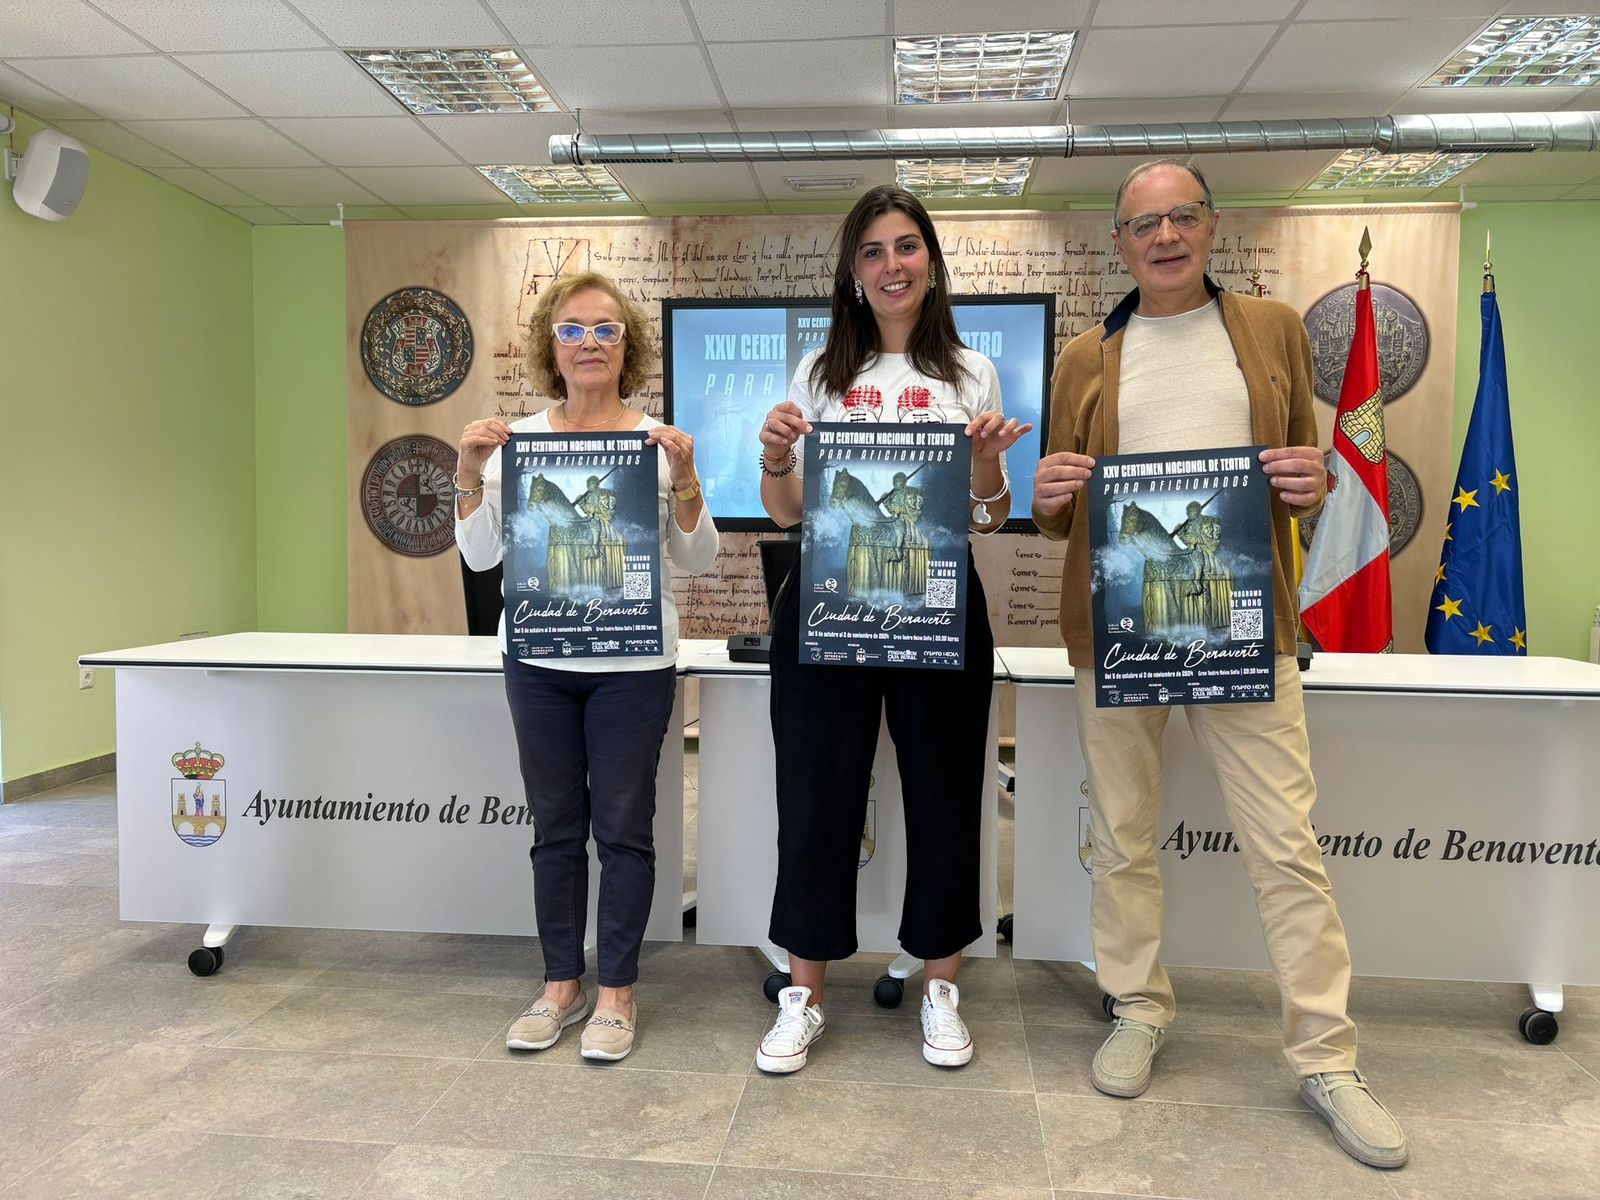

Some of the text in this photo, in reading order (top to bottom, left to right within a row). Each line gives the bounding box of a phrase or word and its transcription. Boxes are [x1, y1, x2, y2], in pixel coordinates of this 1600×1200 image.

[798, 318, 810, 328] XXV
[705, 334, 736, 360] XXV
[798, 332, 825, 342] PARA
[705, 373, 774, 396] PARA
[516, 440, 642, 452] XXV CERTAMEN NACIONAL DE TEATRO
[819, 432, 955, 446] XXV CERTAMEN NACIONAL DE TEATRO
[516, 455, 641, 467] PARA AFICIONADOS
[819, 449, 952, 462] PARA AFICIONADOS
[1103, 457, 1250, 479] XXV CERTAMEN NACIONAL DE TEATRO
[1104, 475, 1249, 495] PARA AFICIONADOS
[513, 598, 653, 624] Ciudad de Benavente
[808, 602, 956, 631] Ciudad de Benavente
[1103, 639, 1264, 670] Ciudad de Benavente
[242, 789, 430, 826] Ayuntamiento
[439, 795, 471, 824] de
[1393, 828, 1431, 860] de
[1440, 829, 1600, 866] Benavent
